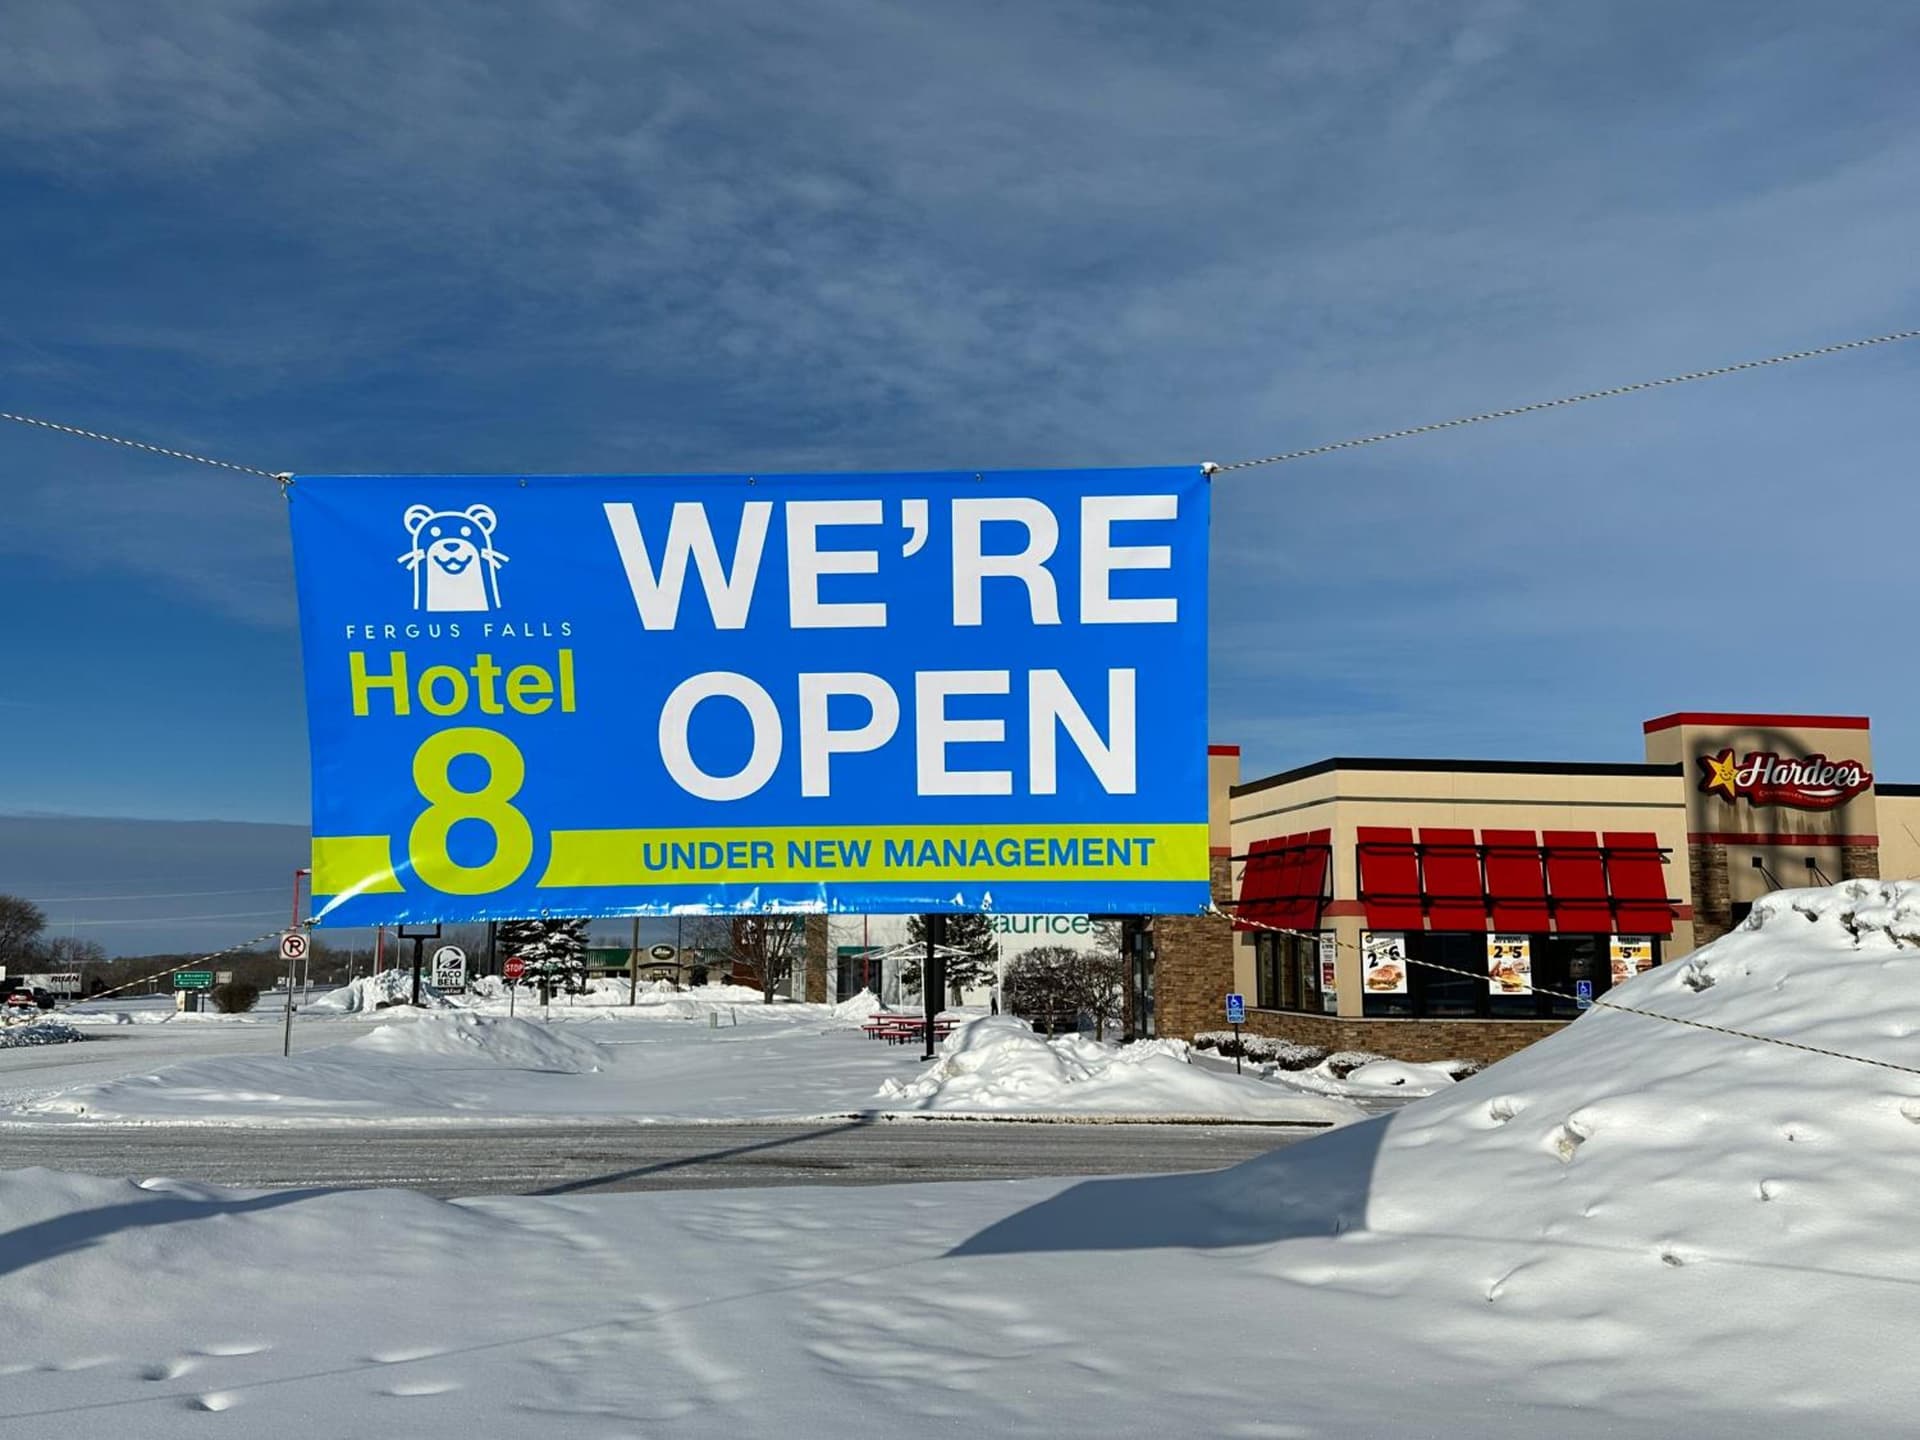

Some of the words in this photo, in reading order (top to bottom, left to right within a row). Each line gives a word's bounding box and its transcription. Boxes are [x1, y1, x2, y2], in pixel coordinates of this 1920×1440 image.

[346, 624, 461, 640] FERGUS
[484, 621, 572, 638] FALLS
[349, 649, 576, 717] Hotel
[658, 668, 1137, 801] OPEN
[408, 727, 533, 895] 8
[643, 841, 775, 871] UNDER
[787, 840, 872, 868] NEW
[884, 837, 1155, 868] MANAGEMENT
[992, 914, 1107, 934] aurices
[436, 970, 462, 978] TACO
[506, 963, 524, 973] STOP
[437, 978, 460, 986] BELL
